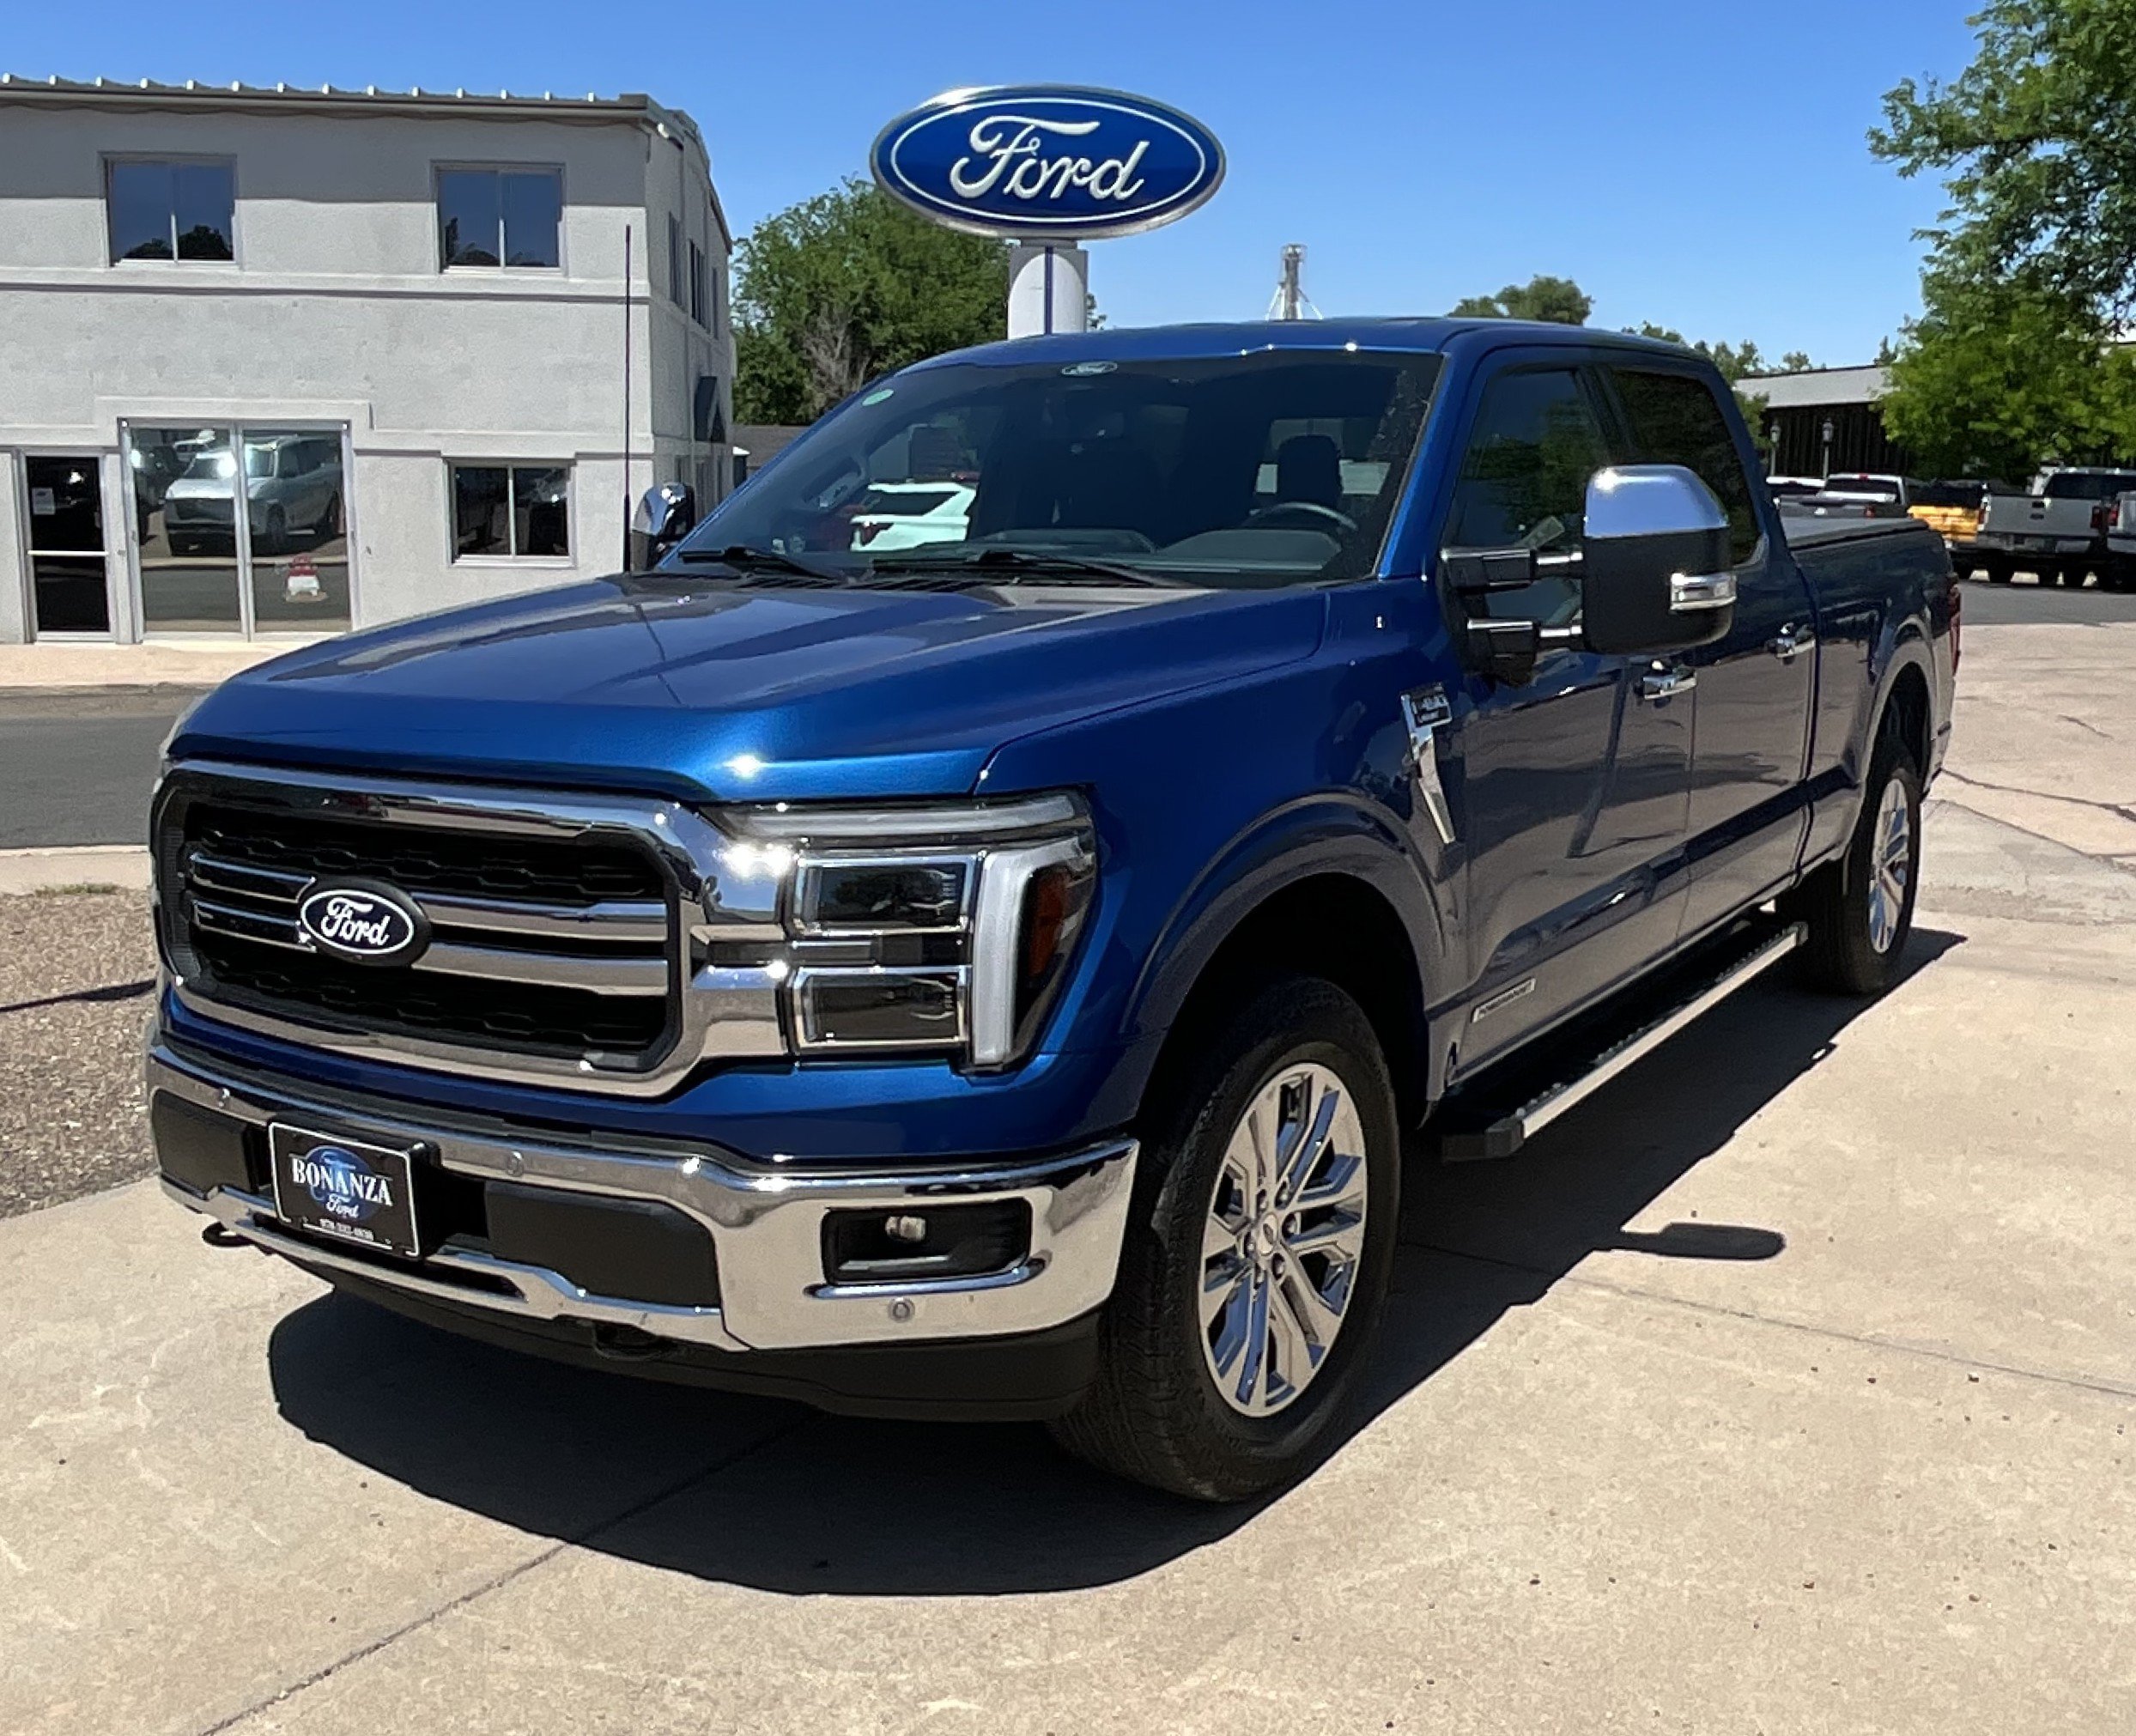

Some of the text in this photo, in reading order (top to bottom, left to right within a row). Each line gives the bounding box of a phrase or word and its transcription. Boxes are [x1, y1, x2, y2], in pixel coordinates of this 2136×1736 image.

[949, 114, 1150, 200] Ford
[320, 896, 391, 945] Ford
[291, 1157, 393, 1207] BONANZA
[325, 1193, 360, 1219] Ford
